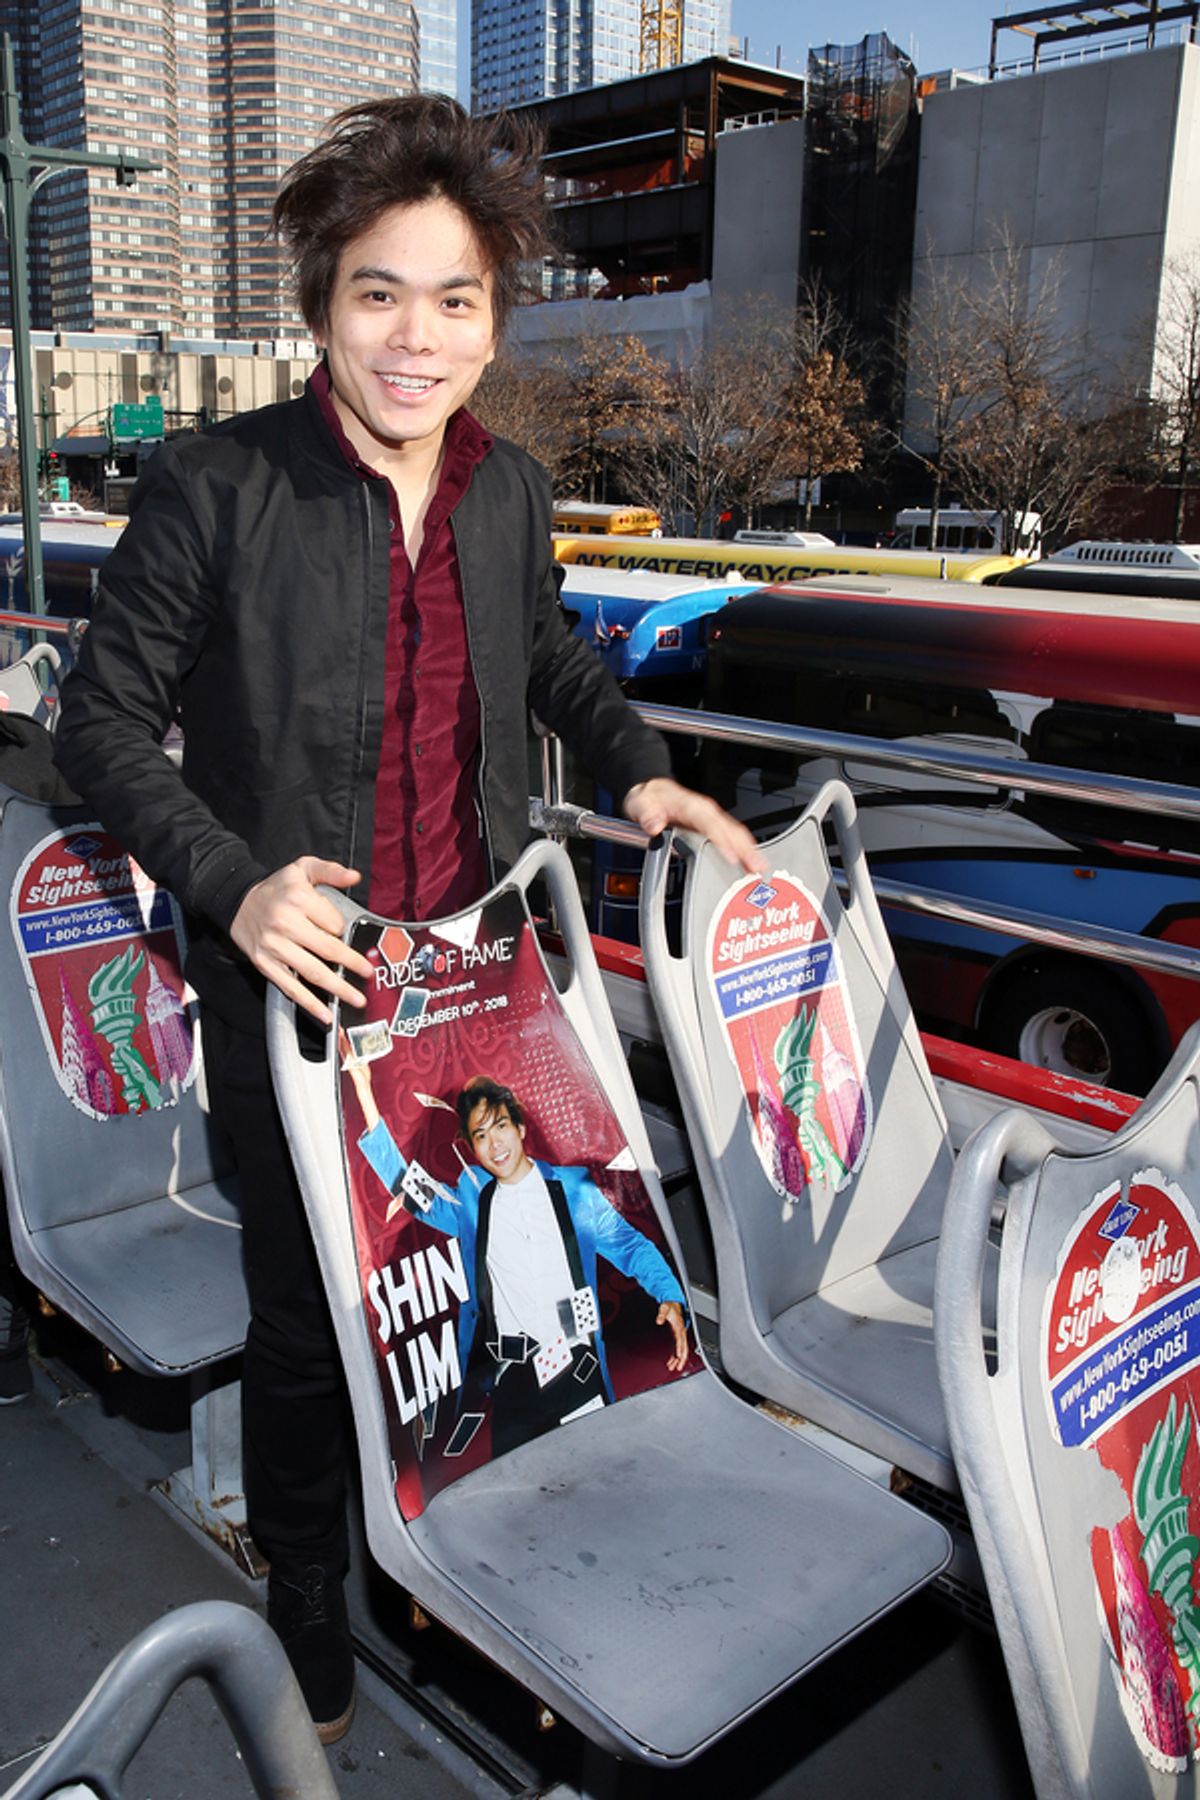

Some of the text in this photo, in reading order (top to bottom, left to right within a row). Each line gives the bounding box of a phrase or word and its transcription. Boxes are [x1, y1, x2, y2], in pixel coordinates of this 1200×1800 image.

[575, 553, 869, 581] NY WATERWAY.C
[39, 852, 130, 884] New York
[718, 919, 817, 963] Sightseeing
[727, 901, 800, 939] New York
[374, 937, 512, 991] RIDE OF FAME
[427, 979, 476, 999] mminent
[397, 1006, 460, 1034] DECEMBER
[484, 995, 509, 1012] 2018
[1133, 1219, 1169, 1260] ork
[368, 1237, 470, 1344] SHIN
[1055, 1245, 1189, 1353] Sigheing
[386, 1319, 462, 1426] LIM
[1080, 1330, 1188, 1429] 1-800-669-0051
